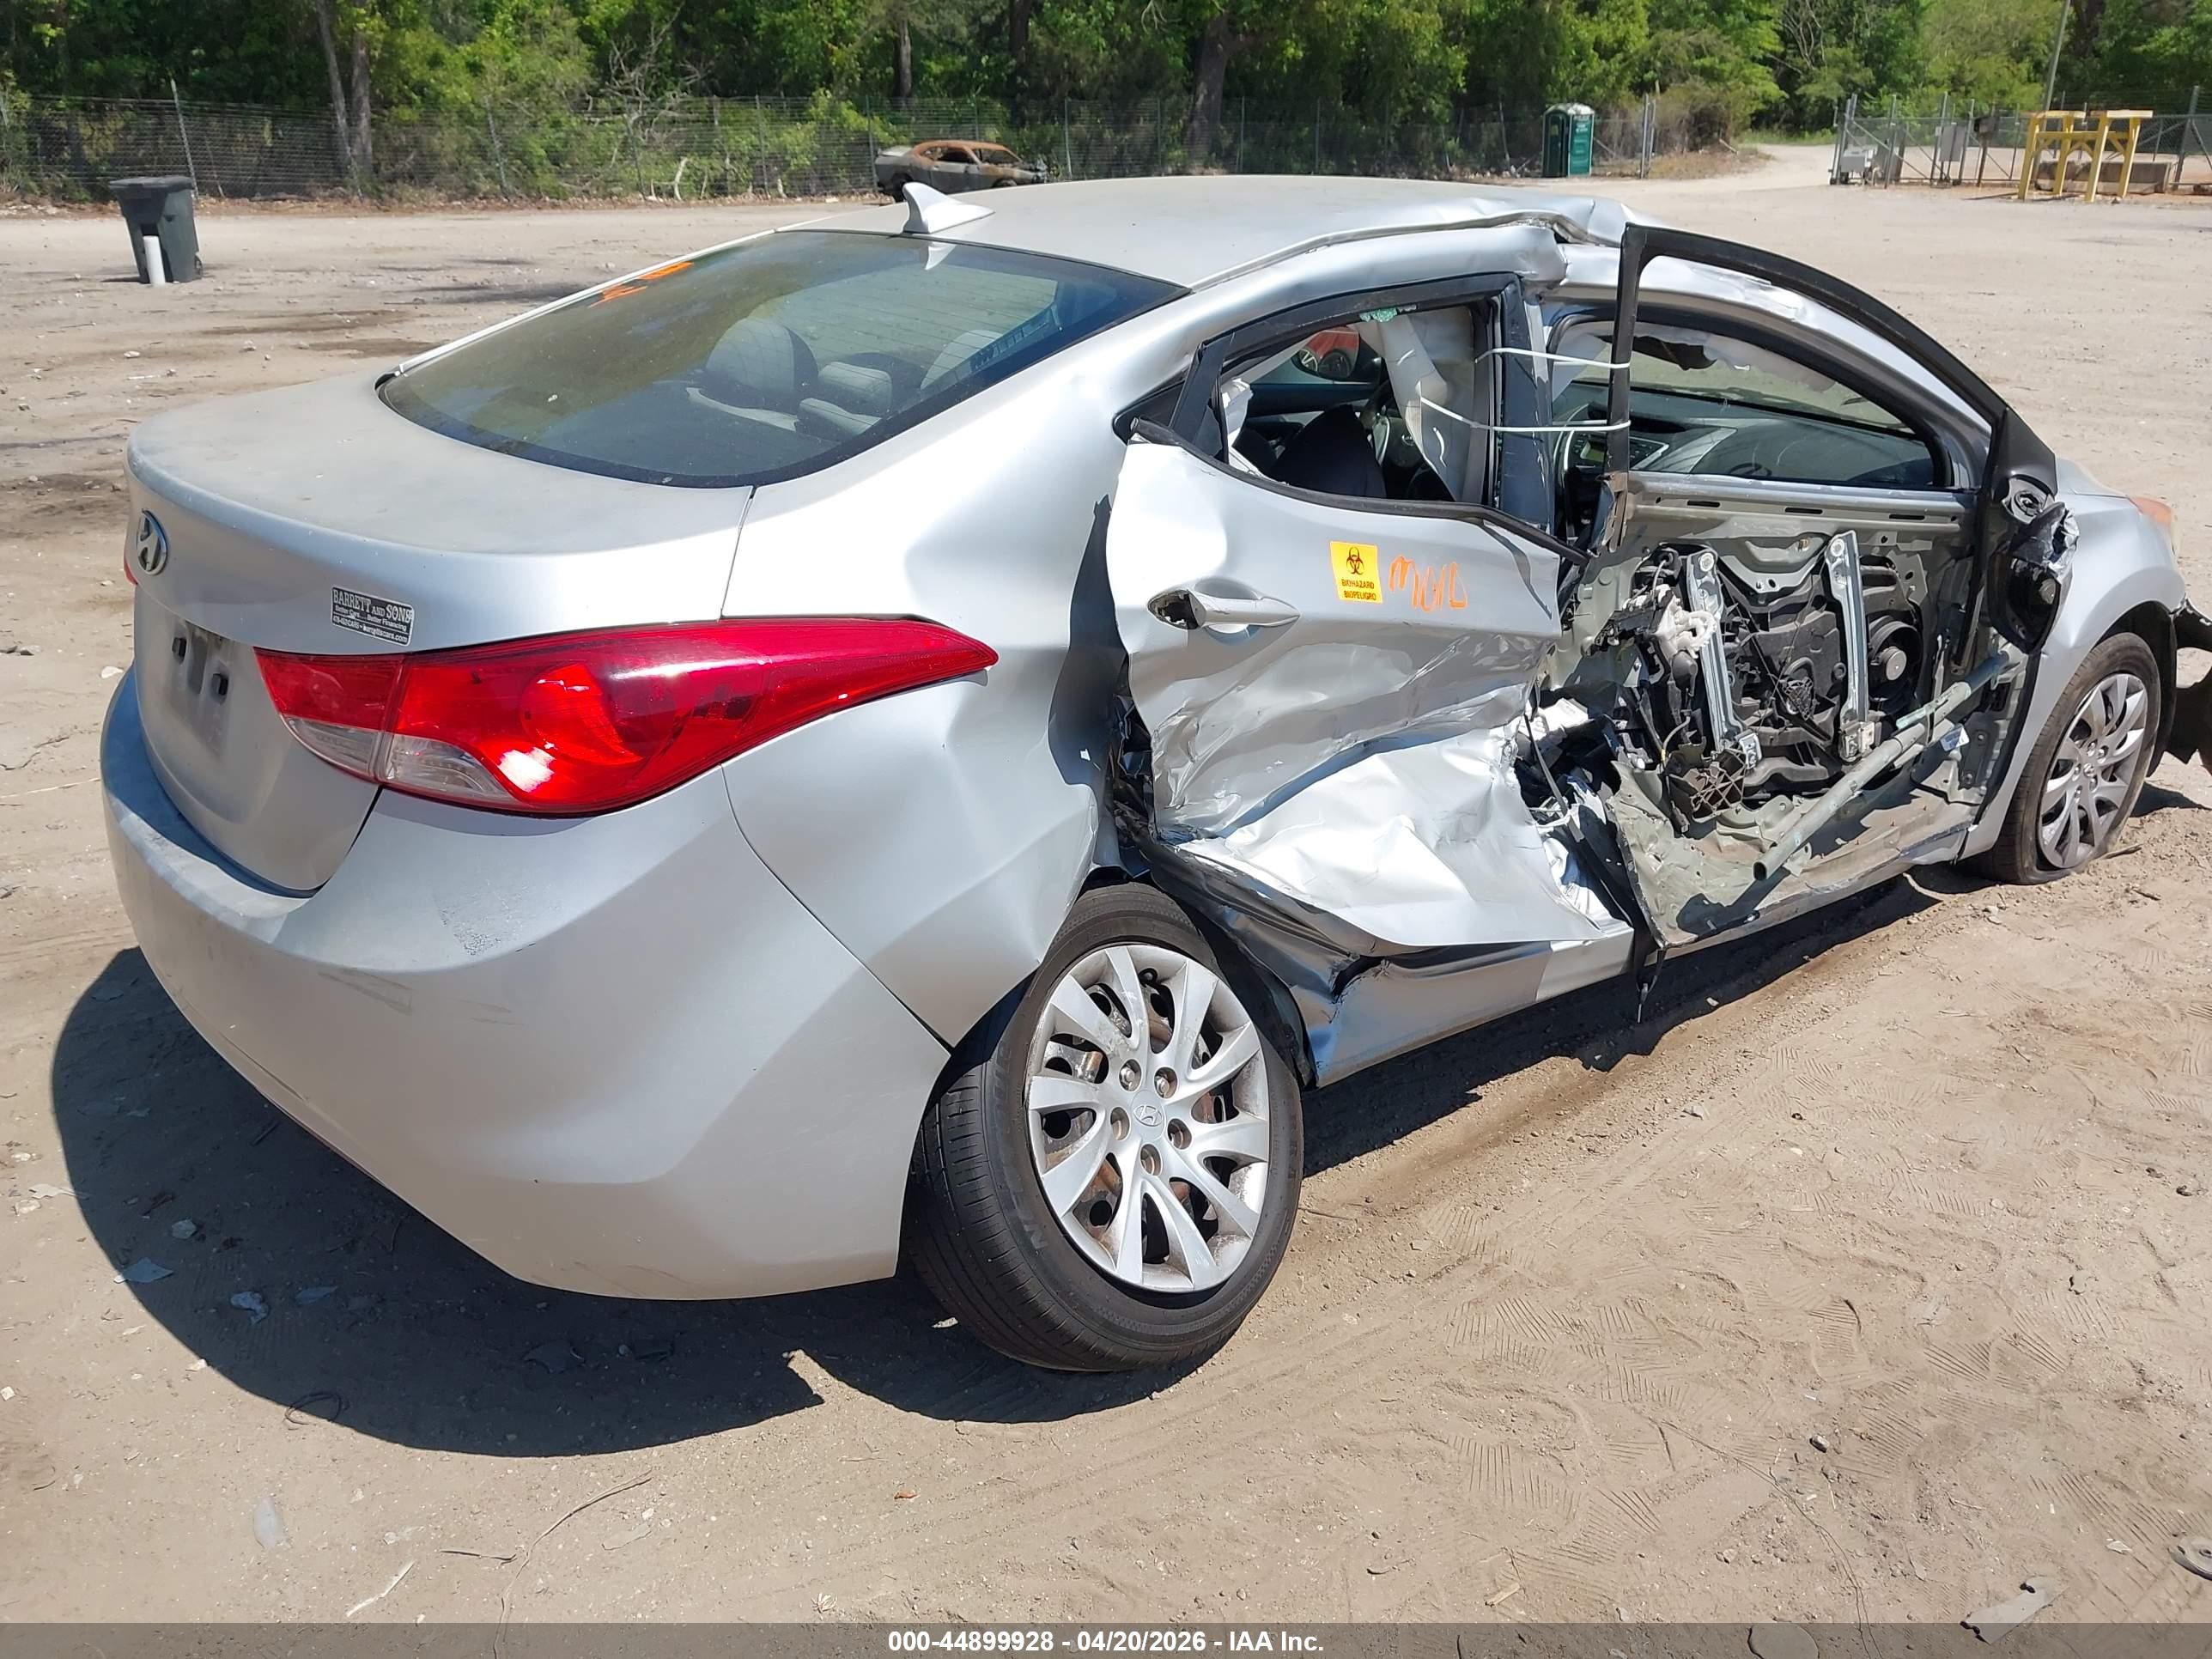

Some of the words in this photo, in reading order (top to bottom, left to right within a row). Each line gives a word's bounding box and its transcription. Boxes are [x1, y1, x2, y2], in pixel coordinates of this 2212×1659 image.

[1341, 579, 1375, 589] BIOHAZARD
[1344, 591, 1376, 600] BIOPELIGRO
[333, 589, 371, 613] BARRETT
[372, 606, 386, 617] AND
[386, 605, 410, 623] SONS
[335, 605, 349, 615] Better
[367, 614, 381, 624] Better
[383, 619, 406, 632] Financing
